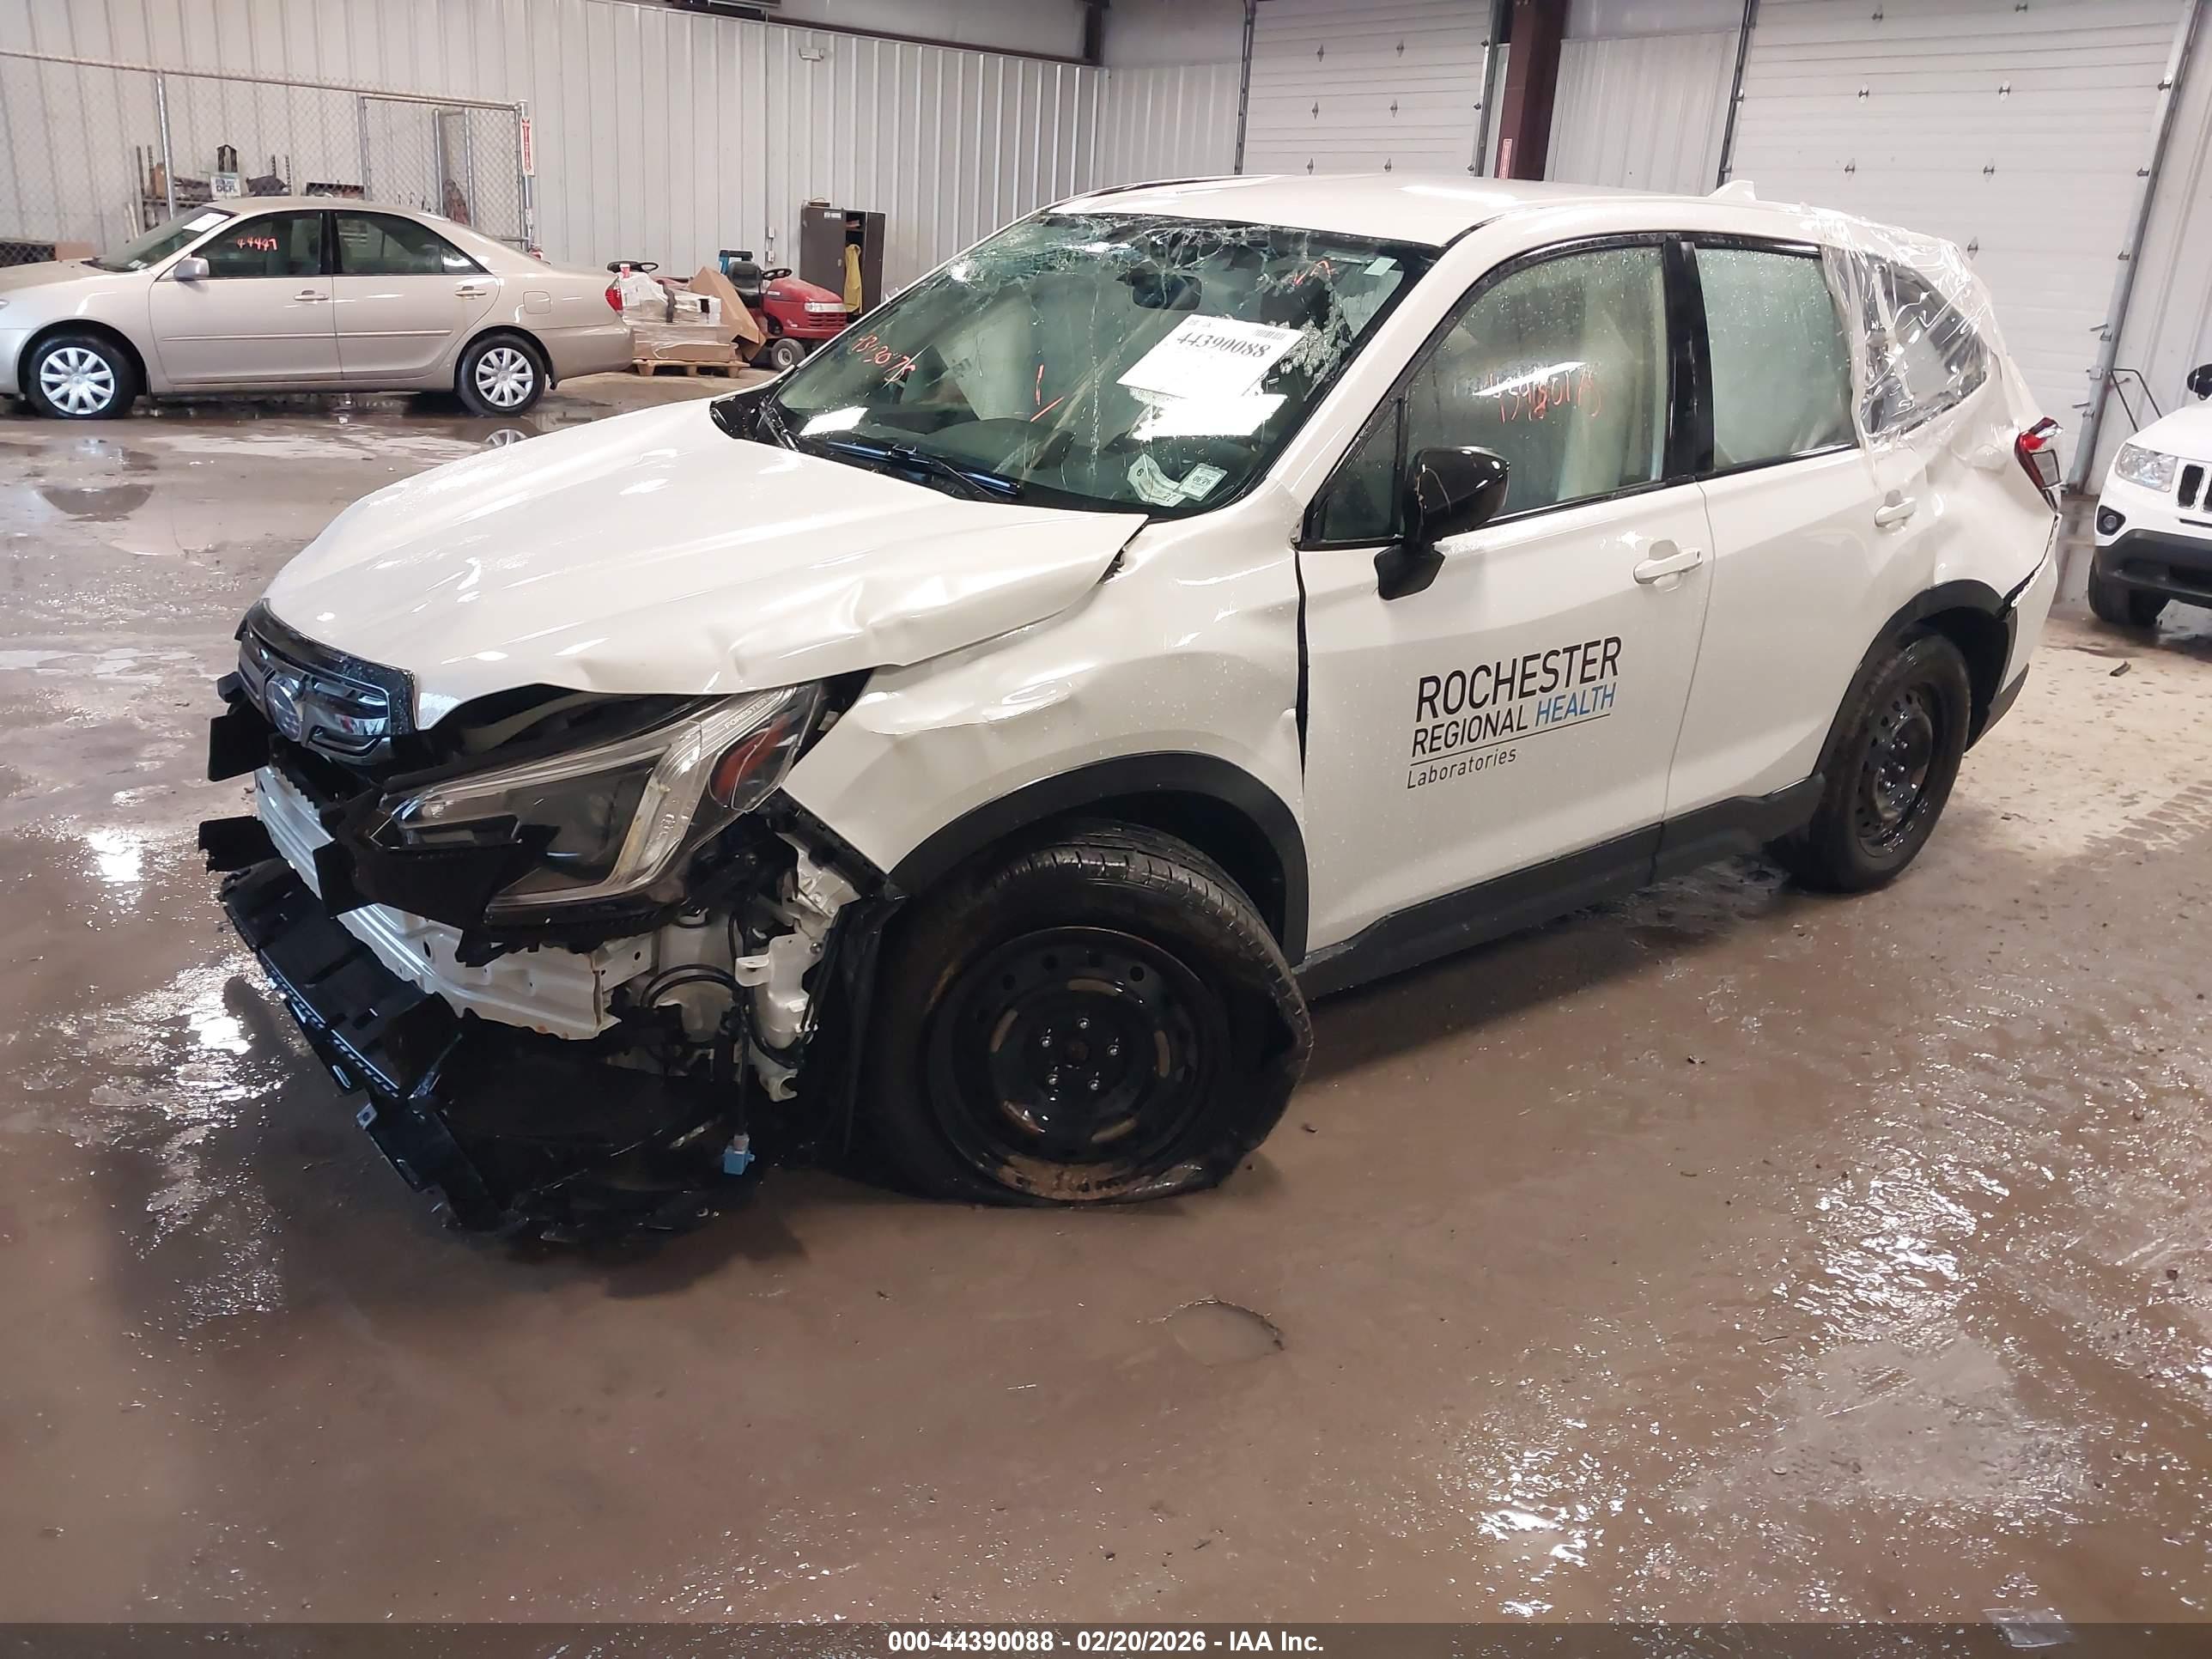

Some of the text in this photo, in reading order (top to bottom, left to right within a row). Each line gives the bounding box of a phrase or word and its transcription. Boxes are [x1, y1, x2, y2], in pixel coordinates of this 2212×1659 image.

[1177, 331, 1271, 357] 44390088
[1136, 468, 1145, 477] 6
[1416, 636, 1622, 723] ROCHESTER
[724, 698, 768, 730] FORESTER
[1412, 682, 1617, 757] REGIONAL HEALTH
[1407, 748, 1517, 789] Laboratories
